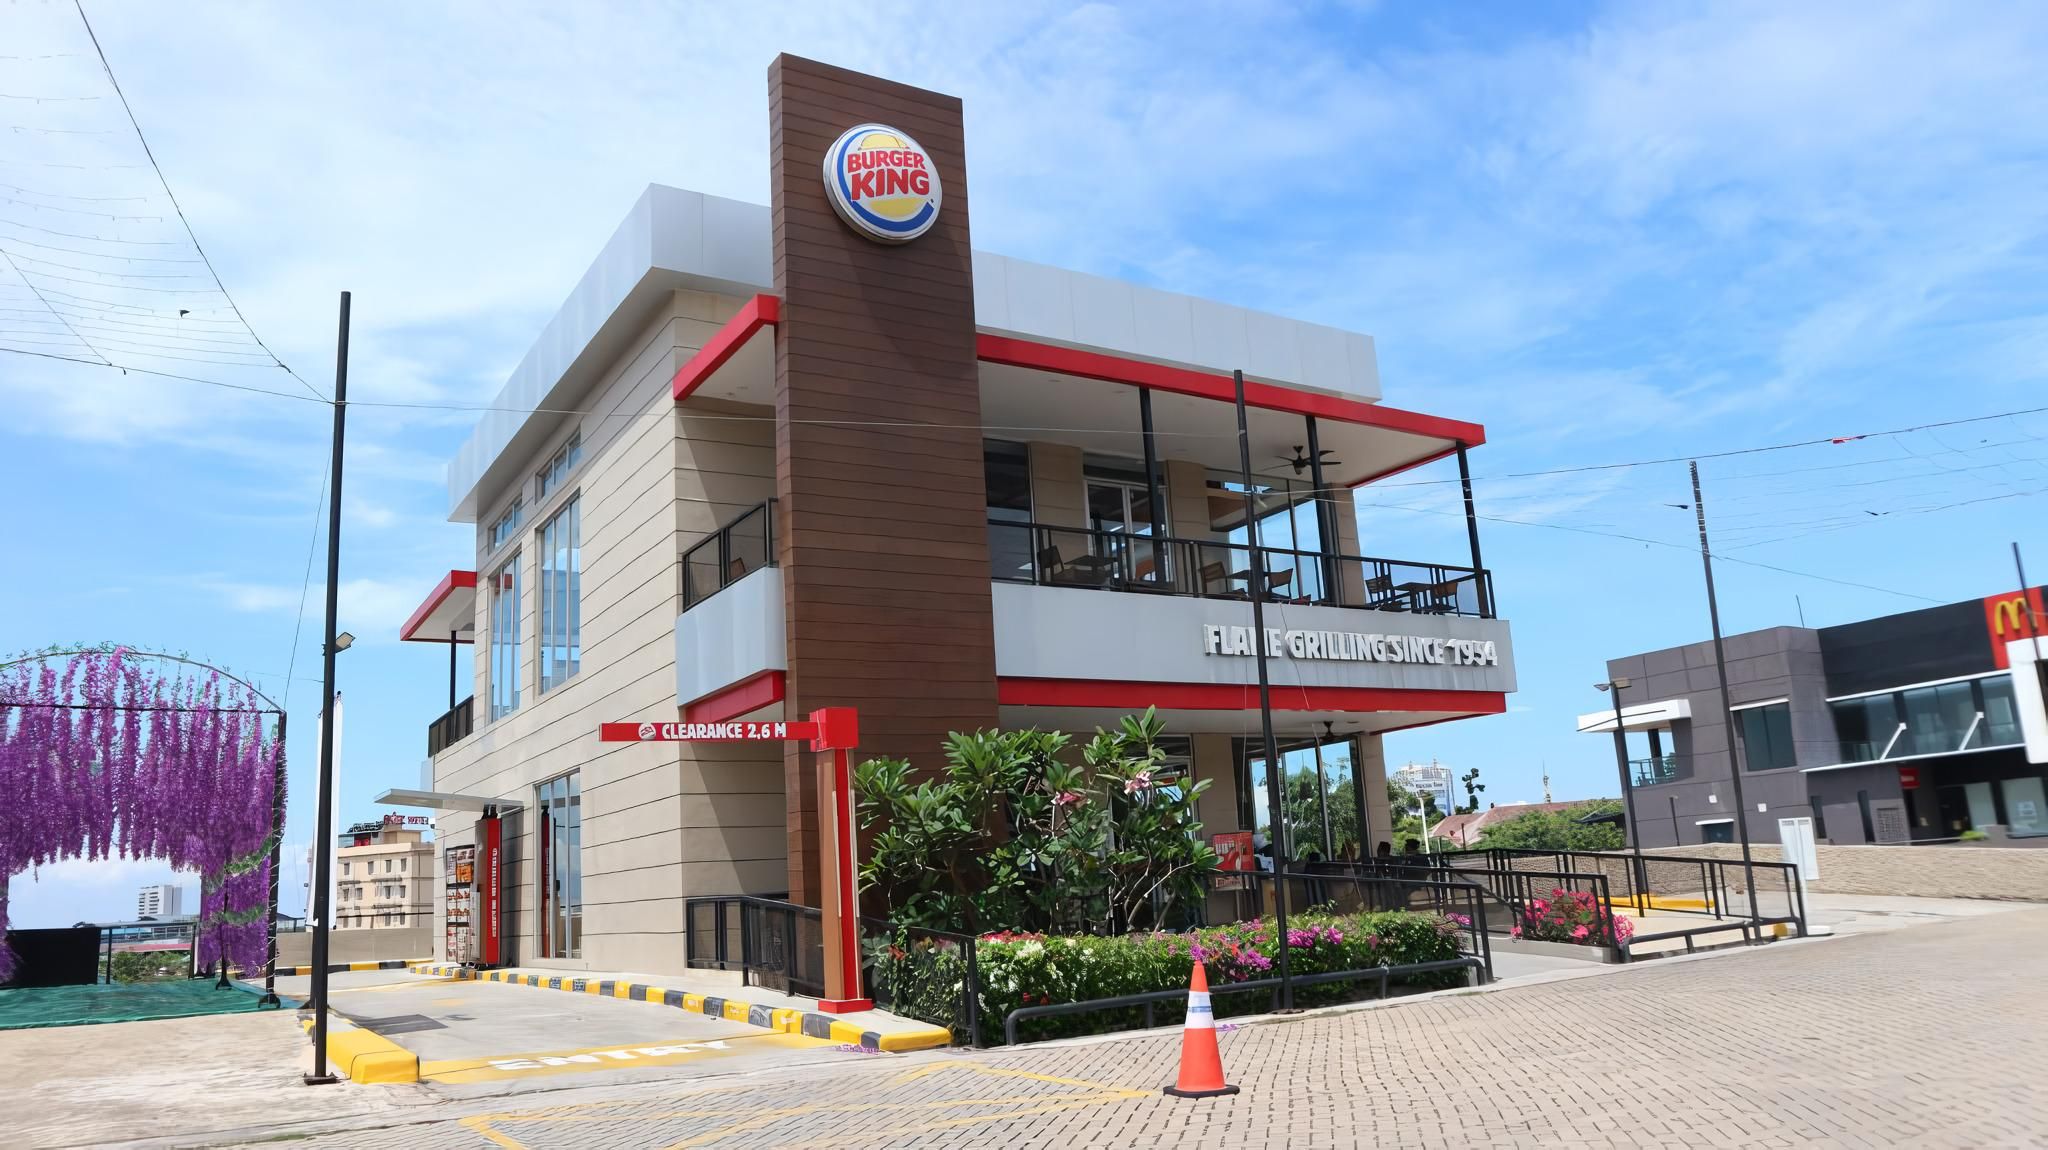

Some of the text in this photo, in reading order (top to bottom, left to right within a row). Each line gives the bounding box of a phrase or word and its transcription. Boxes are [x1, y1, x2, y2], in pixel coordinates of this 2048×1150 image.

[847, 151, 926, 173] BURGER
[851, 169, 930, 200] KING
[1285, 630, 1387, 662] GRILLING
[1386, 635, 1445, 665] SINCE
[1445, 639, 1498, 666] 1954
[662, 723, 742, 739] CLEARANCE
[747, 723, 770, 739] 2,6
[774, 722, 787, 738] M
